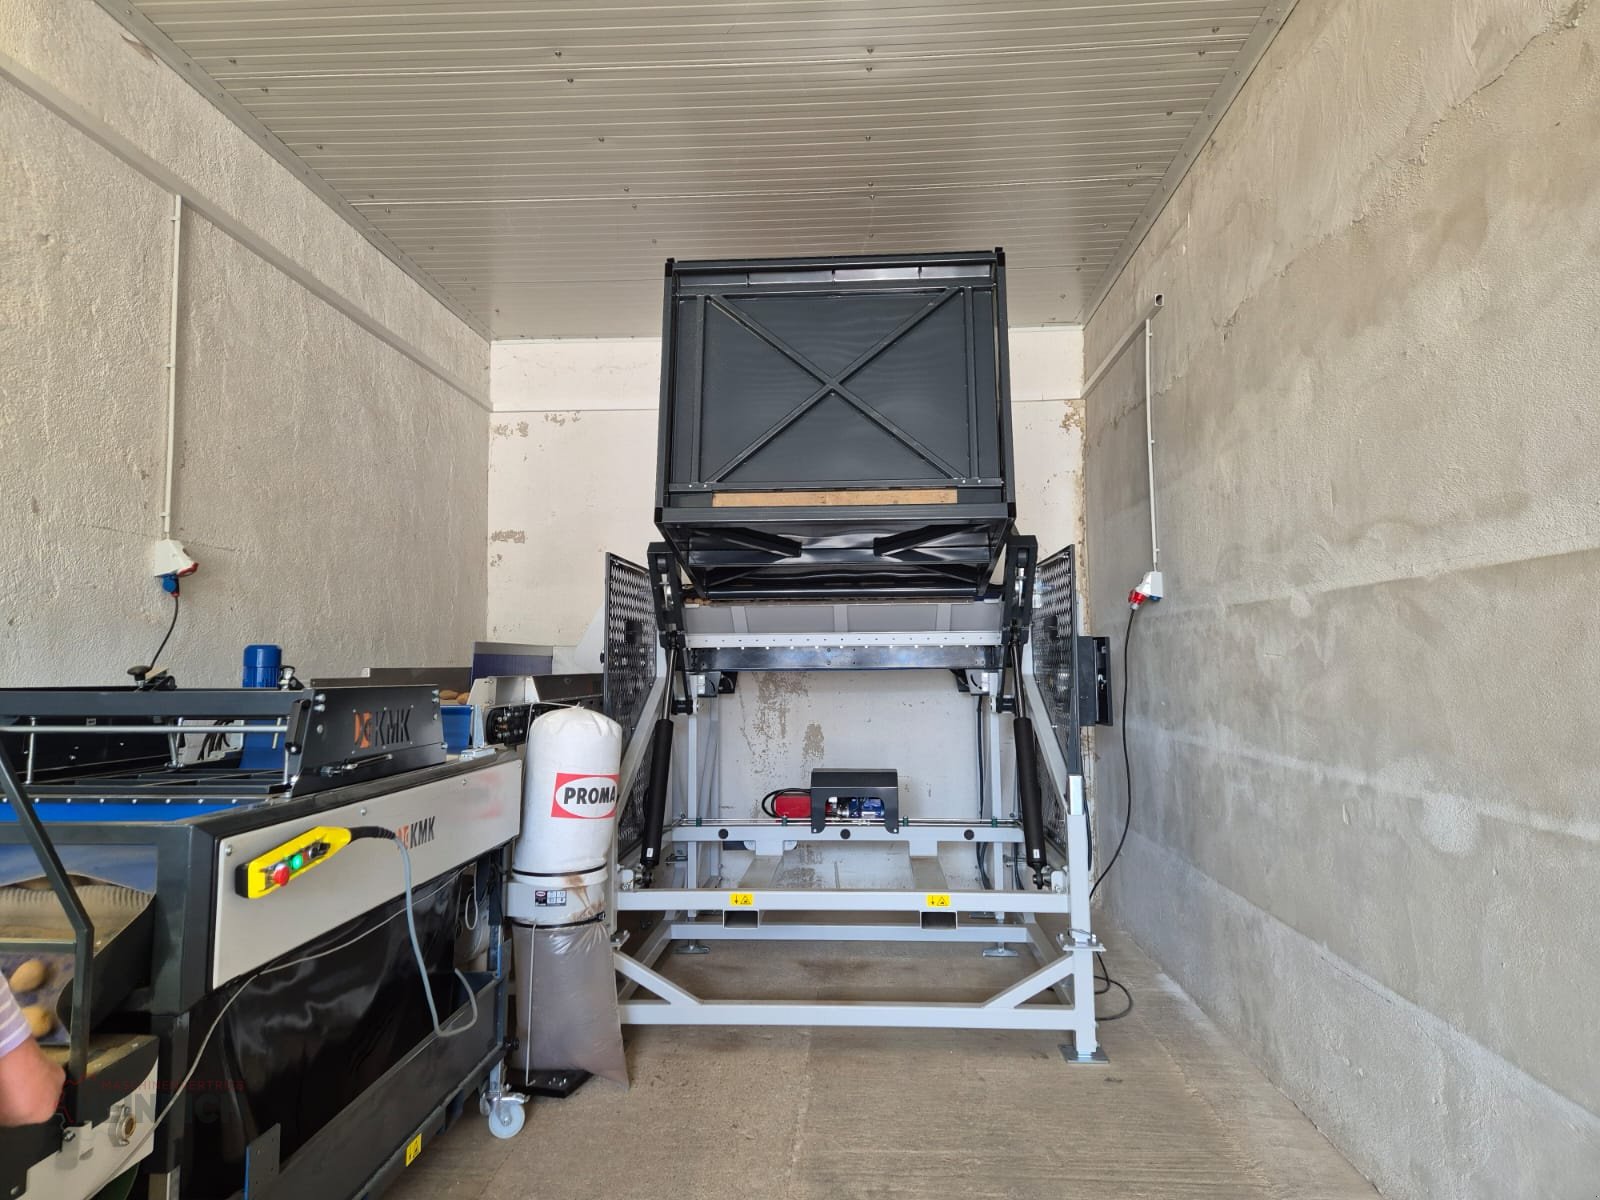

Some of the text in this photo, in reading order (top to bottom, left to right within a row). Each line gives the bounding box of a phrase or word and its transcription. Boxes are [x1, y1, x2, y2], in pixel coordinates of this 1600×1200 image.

[375, 707, 411, 747] KMK
[563, 786, 616, 805] PROMA
[410, 815, 435, 849] KMK
